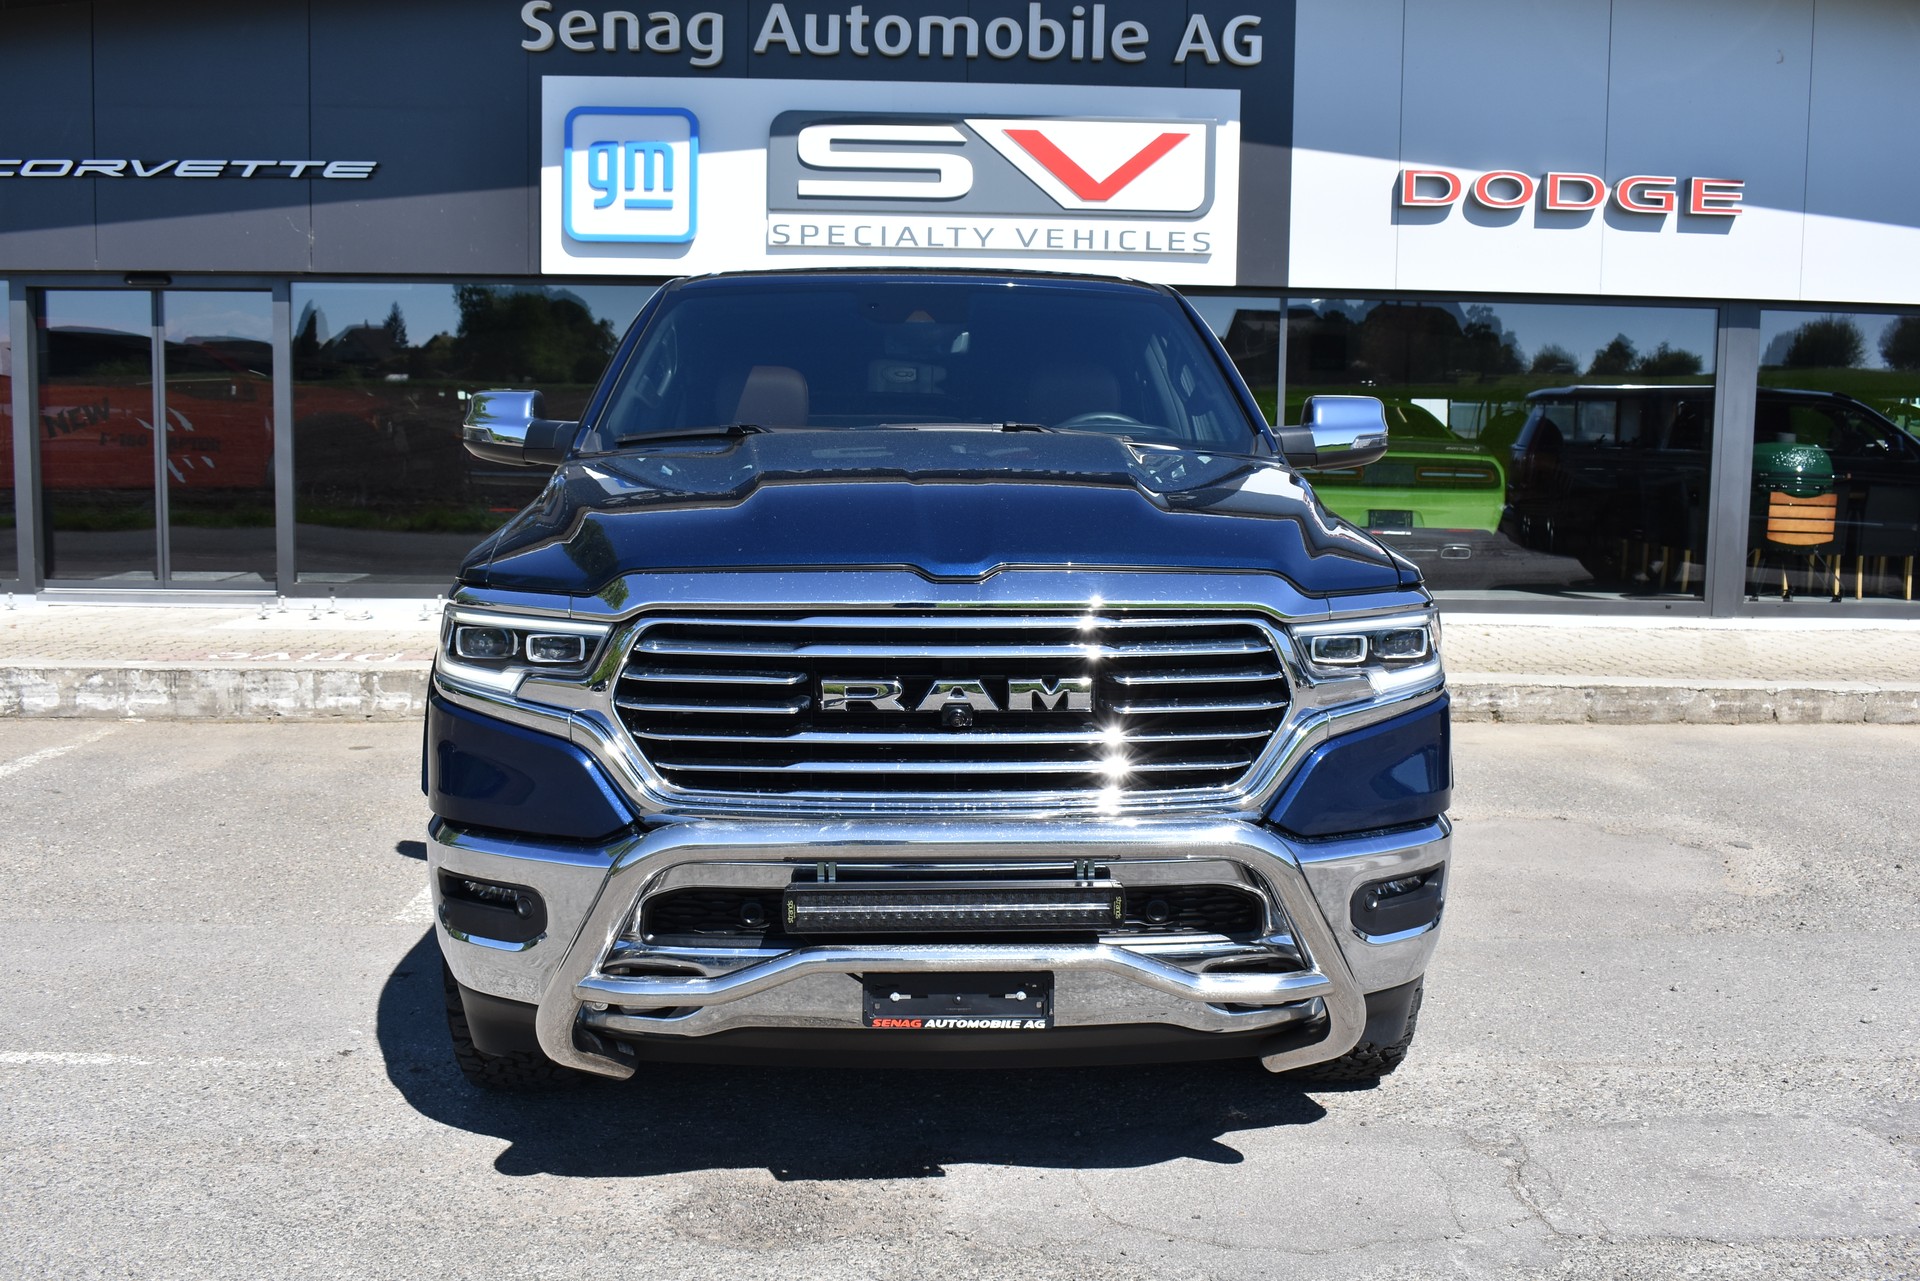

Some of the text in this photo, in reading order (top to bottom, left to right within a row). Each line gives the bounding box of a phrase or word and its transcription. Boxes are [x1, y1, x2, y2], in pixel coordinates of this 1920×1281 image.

[520, 0, 1263, 67] Senag Automobile AG
[587, 140, 674, 210] gm
[797, 123, 1191, 202] SV
[1401, 169, 1745, 216] DODGE
[772, 223, 1211, 252] SPECIALTY VEHICLES
[42, 396, 110, 439] NEW
[820, 678, 1092, 712] RAM
[872, 1019, 1046, 1029] SENAG AUTOMOBILE AG
